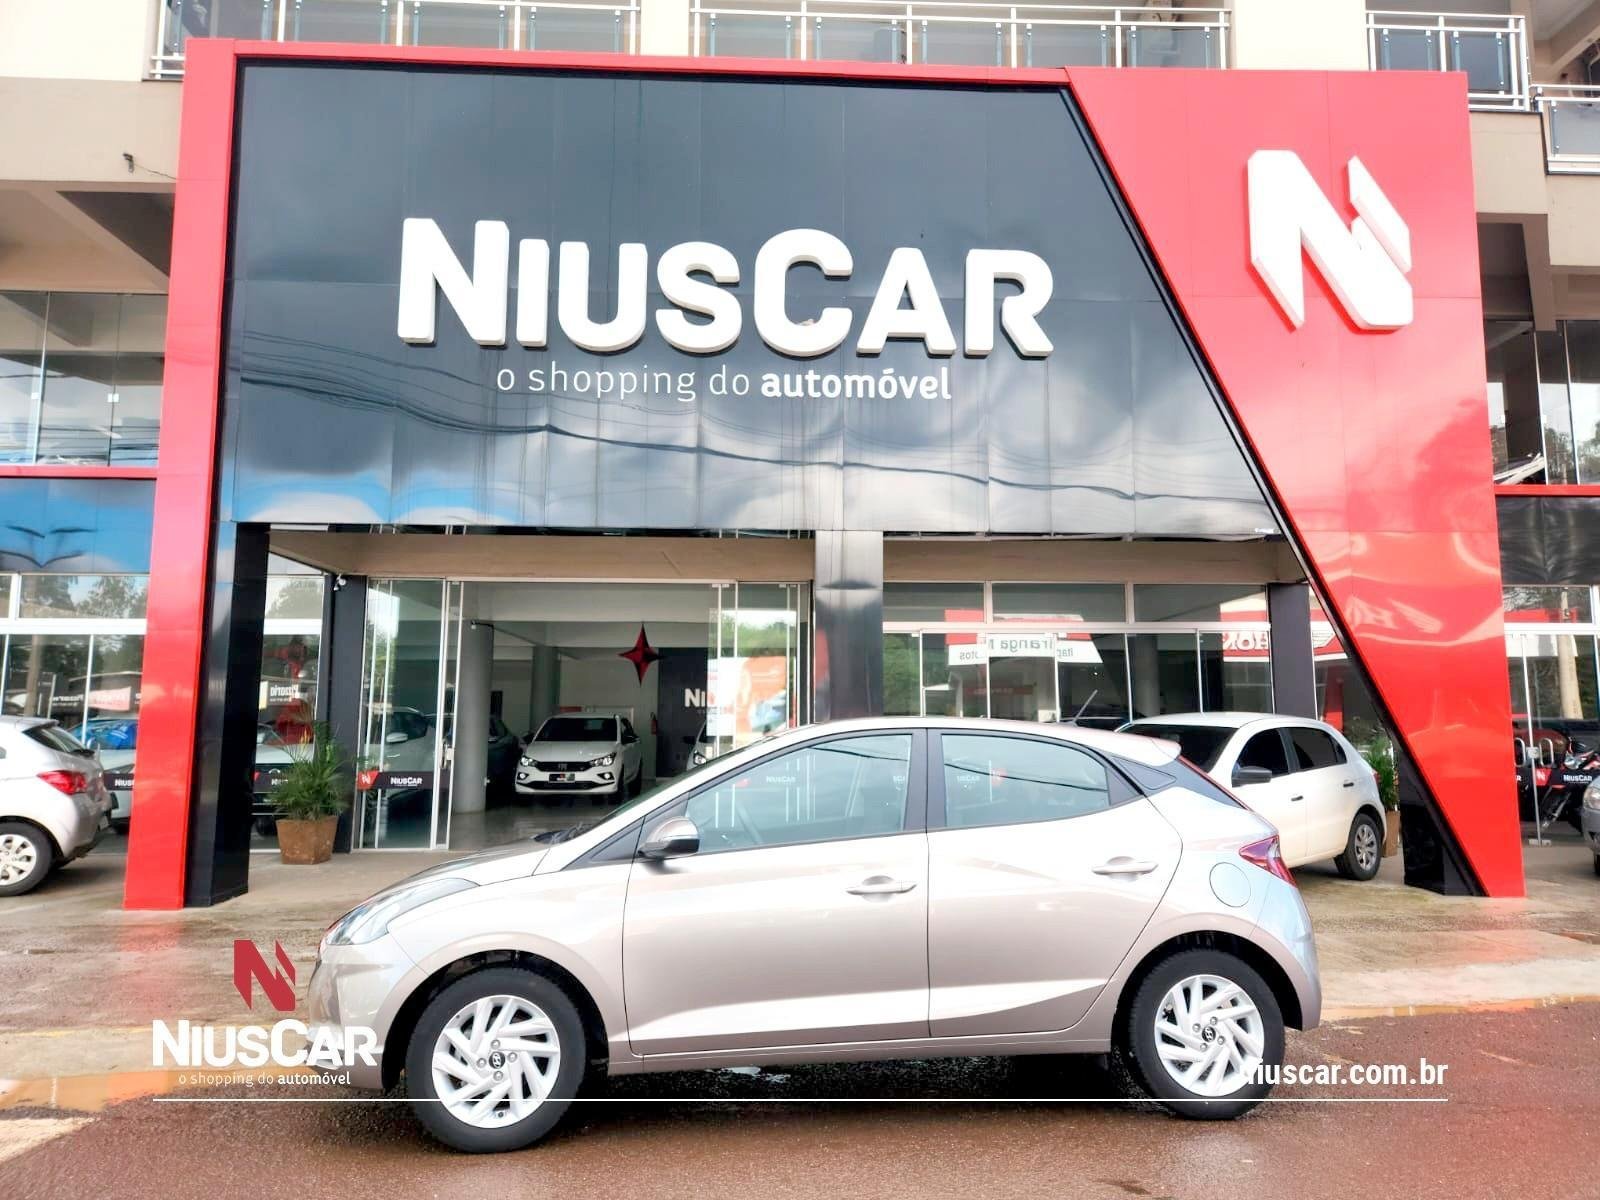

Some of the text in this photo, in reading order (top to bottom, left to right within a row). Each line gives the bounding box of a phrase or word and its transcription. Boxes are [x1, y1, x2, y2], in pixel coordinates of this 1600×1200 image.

[397, 217, 1053, 357] NIUSCAR
[496, 361, 952, 402] o shopping do automóvel
[390, 776, 423, 785] NIUSCAR
